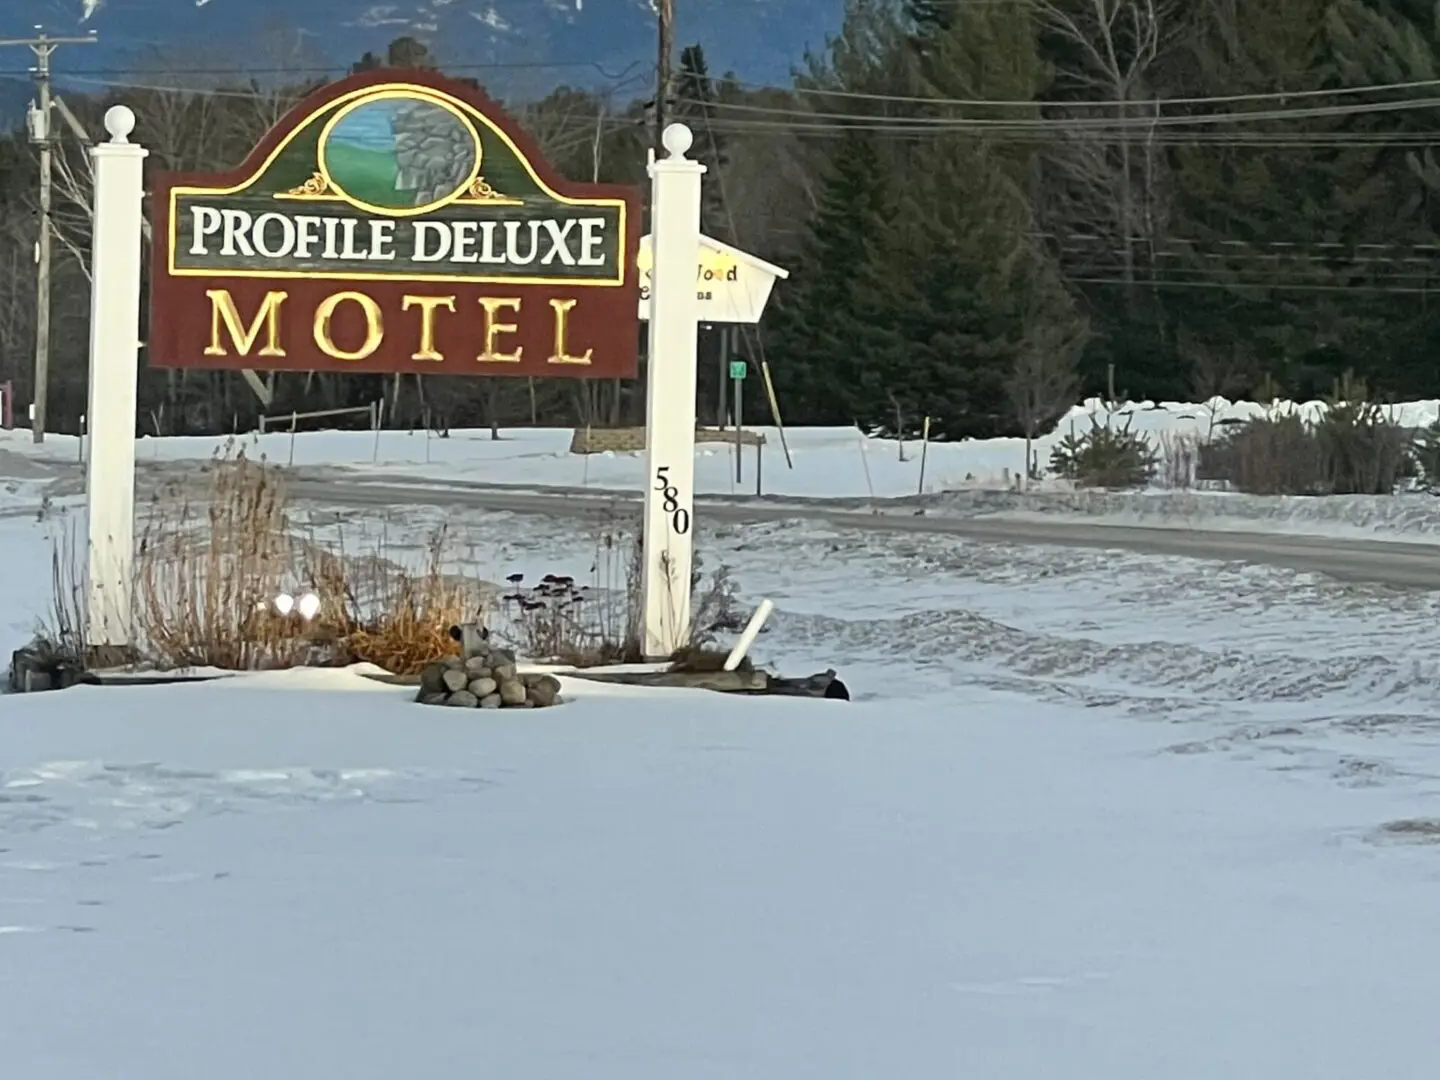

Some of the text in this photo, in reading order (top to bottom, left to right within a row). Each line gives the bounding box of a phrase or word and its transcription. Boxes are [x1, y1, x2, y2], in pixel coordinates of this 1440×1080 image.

[189, 206, 606, 266] PROFILE DELUXE
[203, 289, 593, 365] MOTEL
[654, 466, 690, 535] 580
